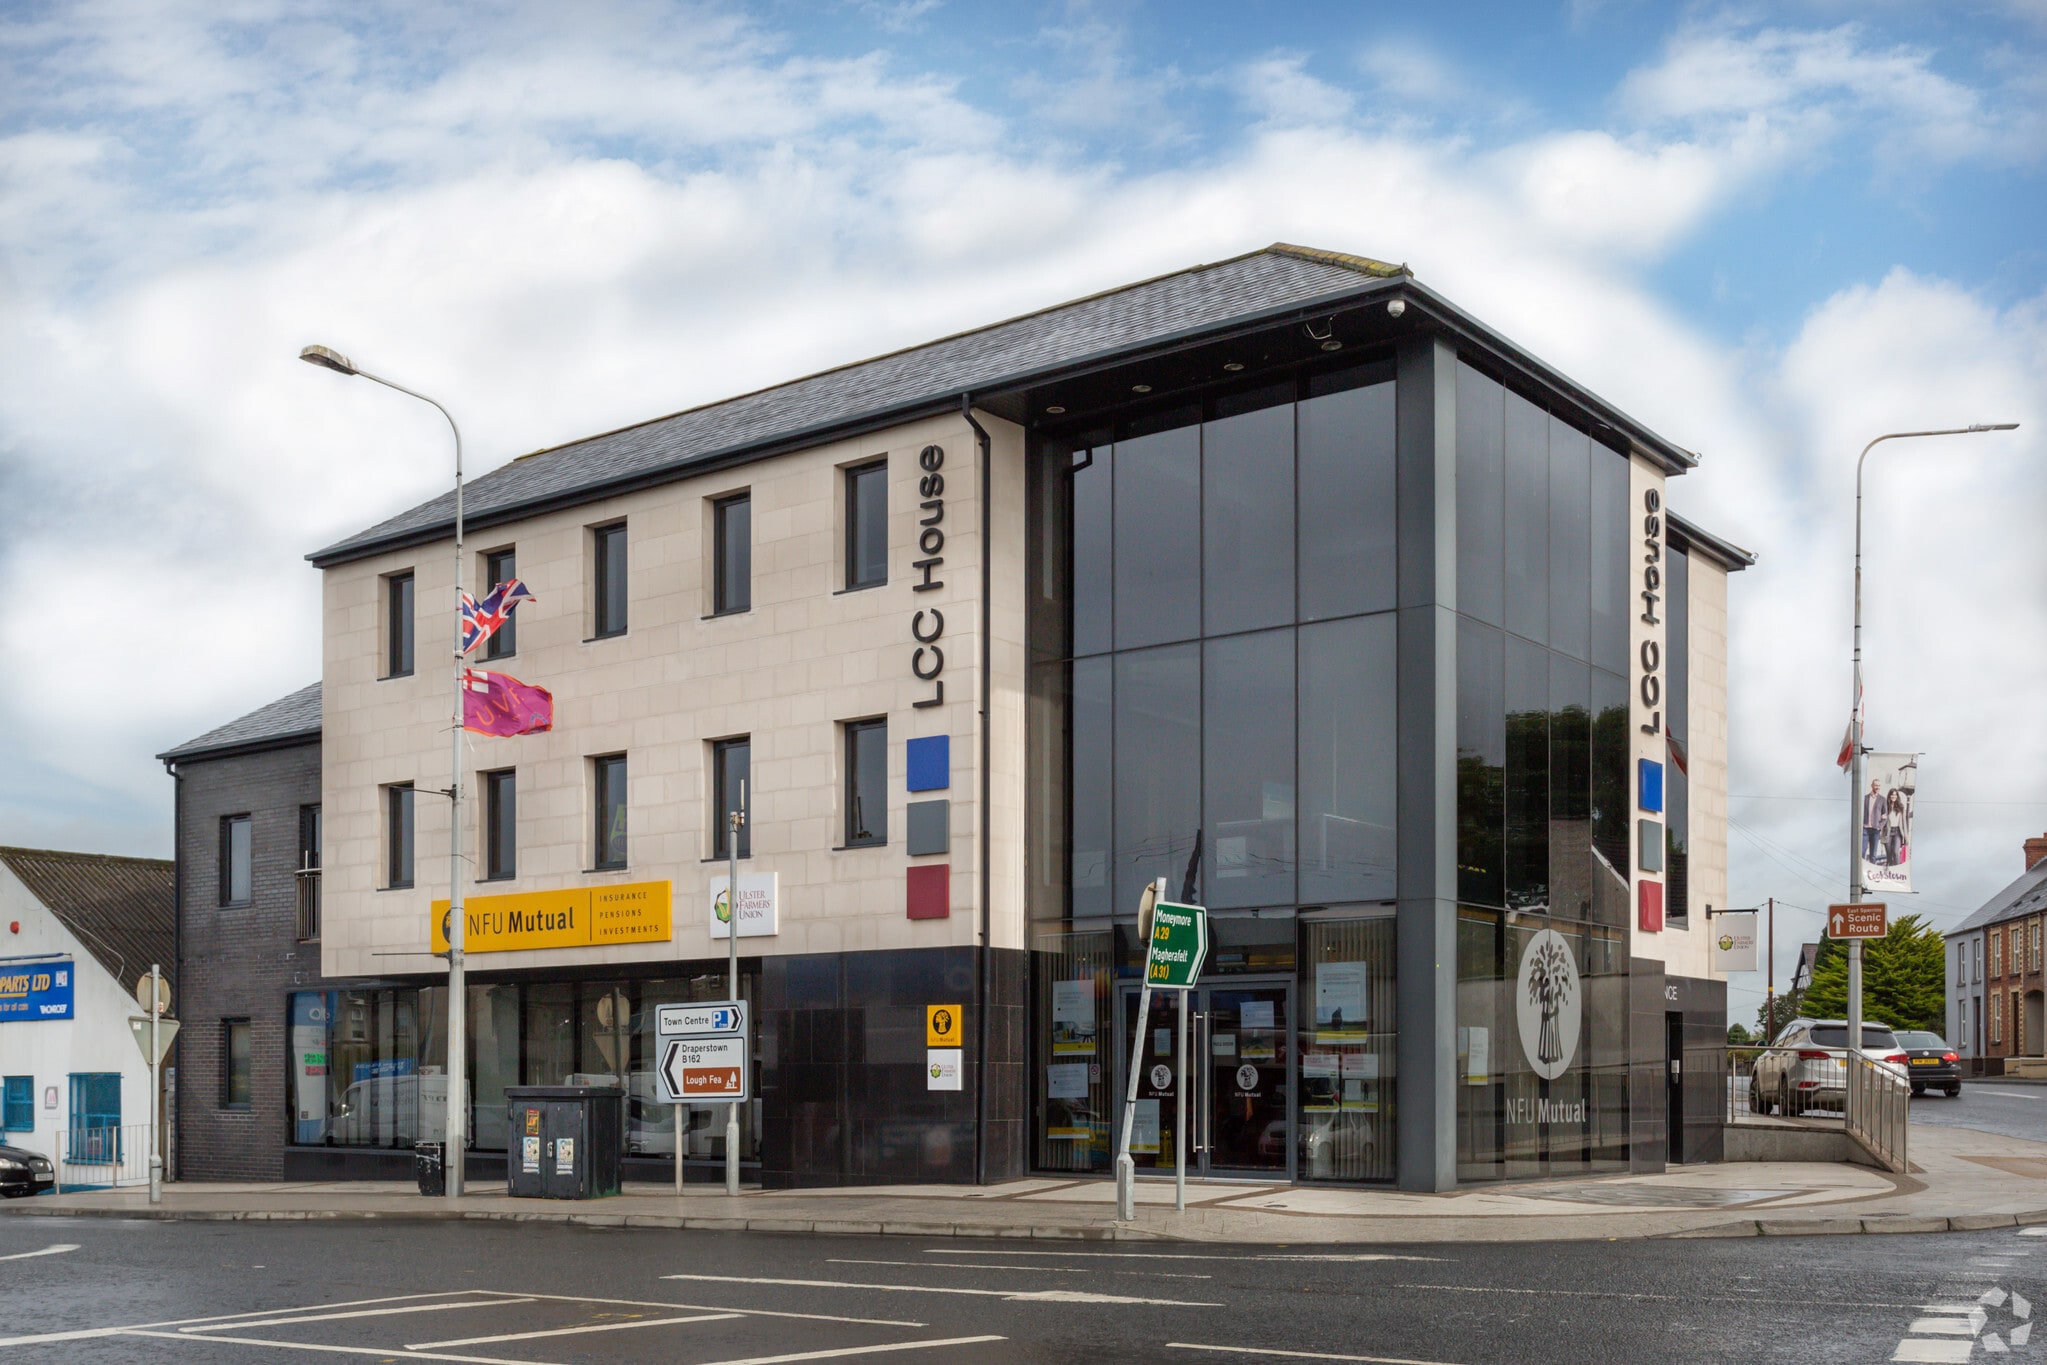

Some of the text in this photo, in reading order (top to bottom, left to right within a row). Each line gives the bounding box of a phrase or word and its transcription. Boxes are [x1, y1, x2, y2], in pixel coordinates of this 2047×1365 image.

[911, 444, 944, 709] LCC House
[1640, 488, 1660, 737] LCC House
[599, 891, 648, 903] INSURANCE
[738, 890, 766, 901] ULSTER
[739, 900, 771, 911] FARMERS
[599, 908, 643, 919] PENSIONS
[738, 910, 763, 920] UNION
[1156, 909, 1192, 927] Moneymore
[1848, 913, 1881, 923] Scenic
[469, 906, 574, 937] NFU Mutual
[599, 924, 660, 936] INVESTMENTS
[1849, 924, 1879, 933] Route
[1151, 947, 1188, 963] Magherafelt
[32, 974, 51, 992] LTD
[664, 1017, 683, 1026] Town
[684, 1016, 710, 1025] Centre
[682, 1044, 728, 1054] Draperstown
[682, 1054, 701, 1064] B162
[686, 1075, 722, 1086] Lough Fea
[1506, 1098, 1586, 1124] NFU Mutual
